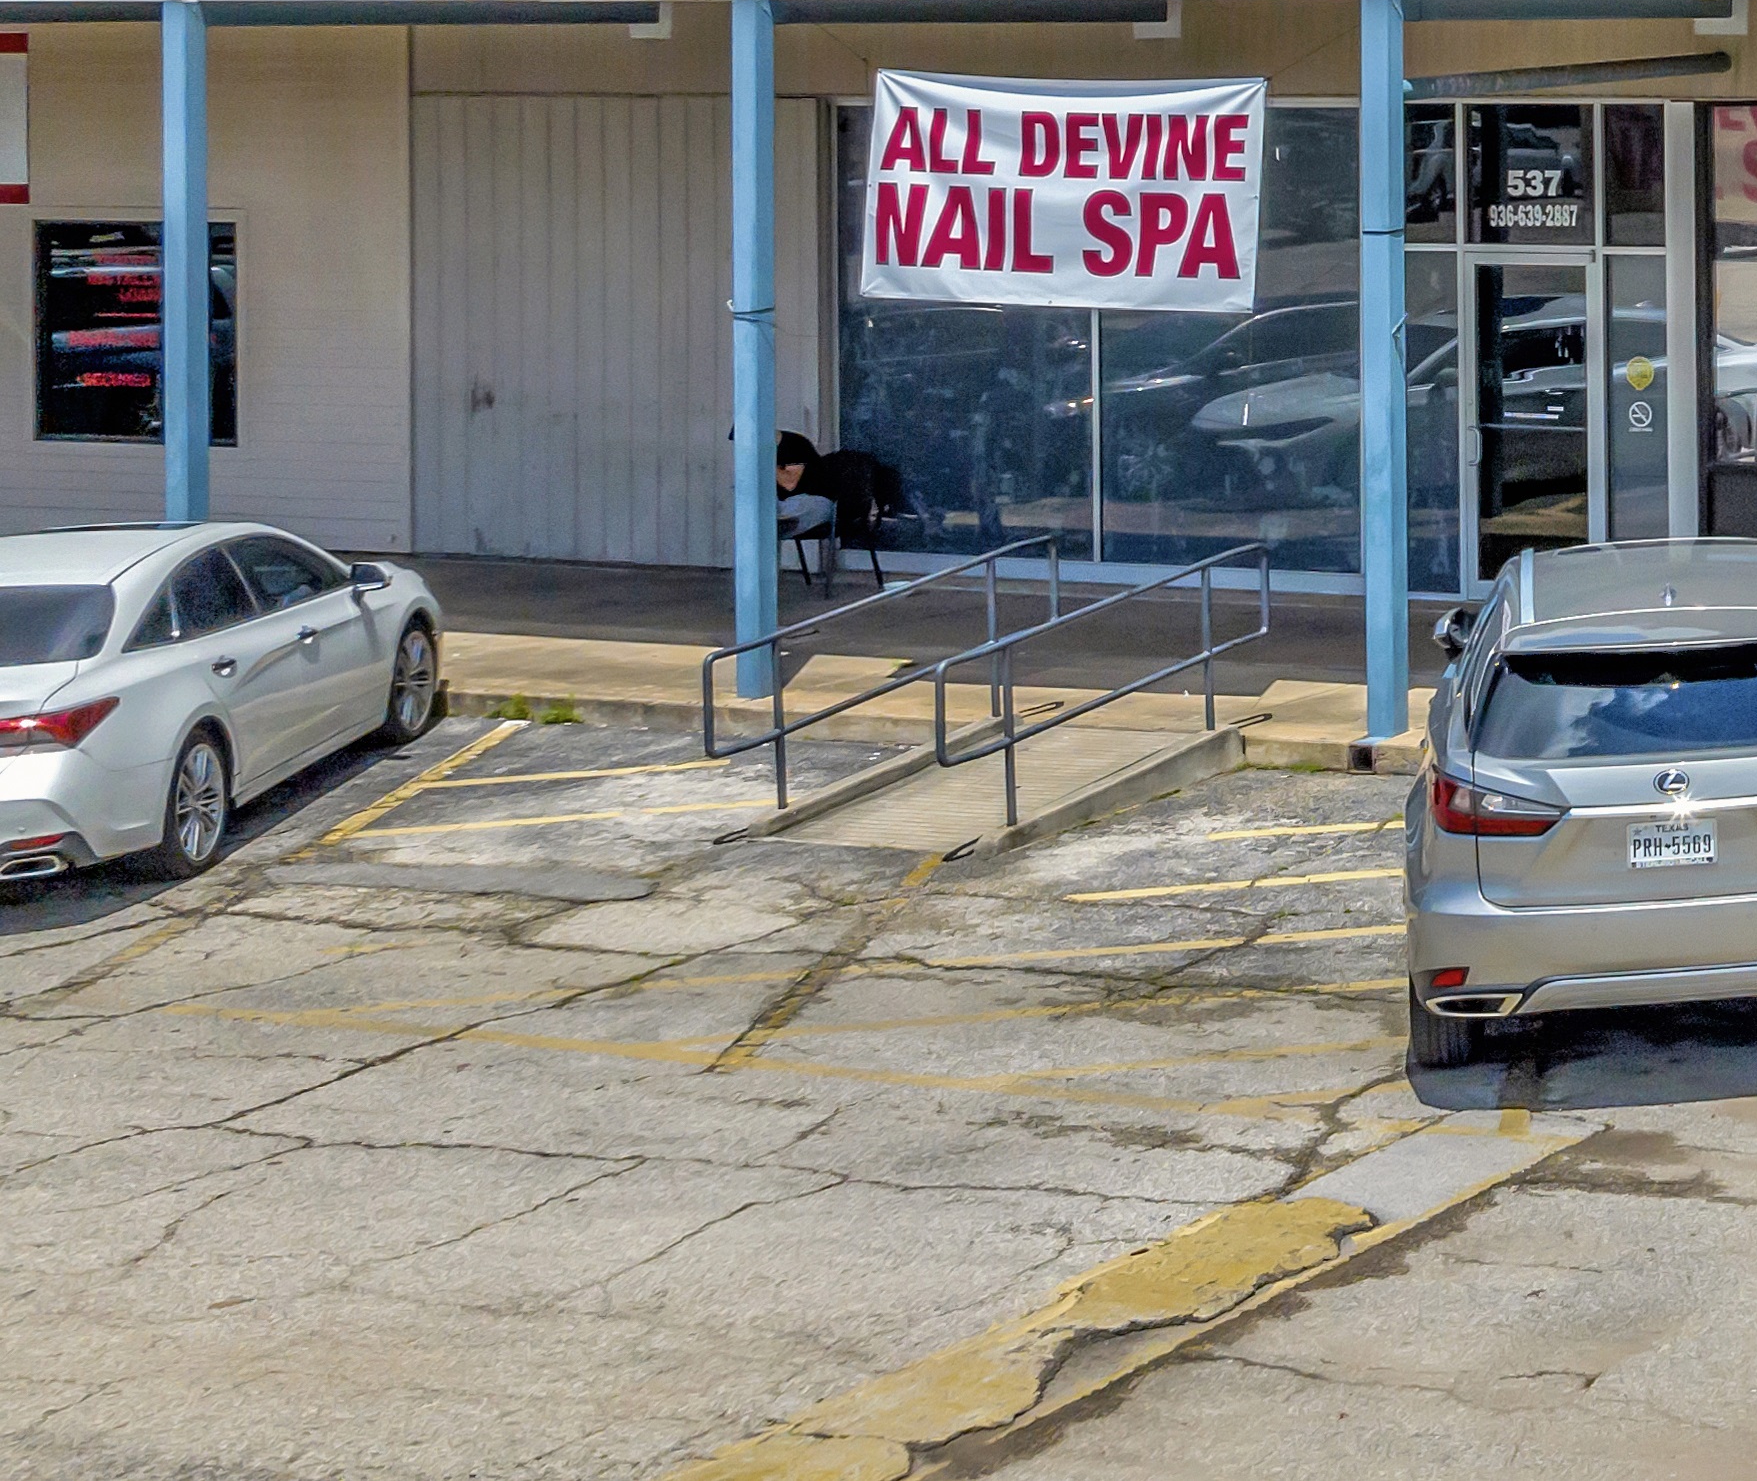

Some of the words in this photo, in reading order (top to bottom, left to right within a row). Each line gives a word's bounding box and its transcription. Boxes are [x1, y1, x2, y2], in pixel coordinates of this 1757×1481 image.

[880, 106, 995, 176] ALL
[1018, 110, 1250, 181] DEVINE
[1506, 169, 1562, 197] 537
[1489, 204, 1578, 227] 936-639-2887
[875, 183, 1054, 274] NAIL
[1082, 189, 1241, 279] SPA
[1655, 823, 1689, 833] TEXAS
[1633, 837, 1662, 858] PRH
